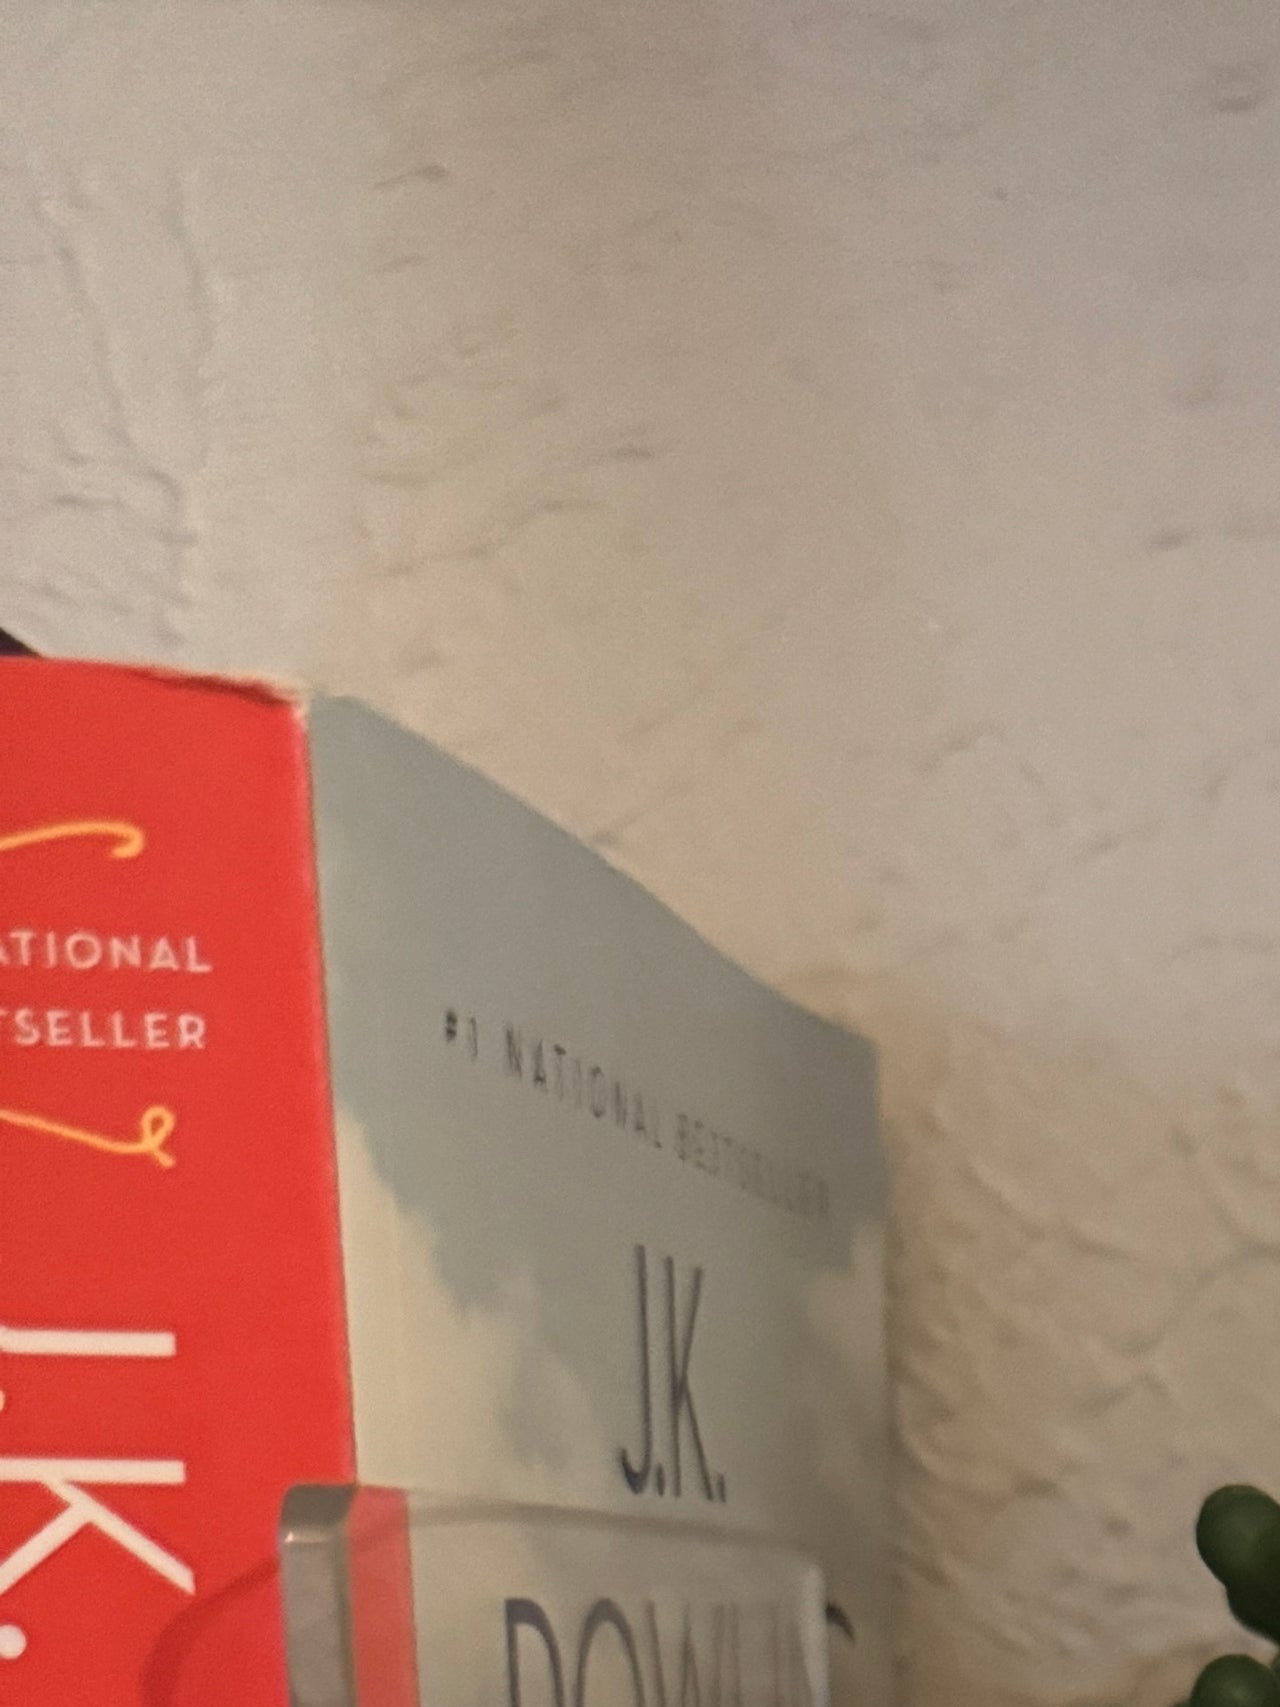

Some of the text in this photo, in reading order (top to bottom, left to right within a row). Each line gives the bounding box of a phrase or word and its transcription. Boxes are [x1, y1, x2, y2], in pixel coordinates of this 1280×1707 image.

[0, 928, 213, 974] TIONAL
[0, 1006, 207, 1051] SELLER
[502, 1019, 664, 1150] NATIONAL
[620, 1243, 727, 1503] J.K.
[0, 1324, 196, 1660] JK.
